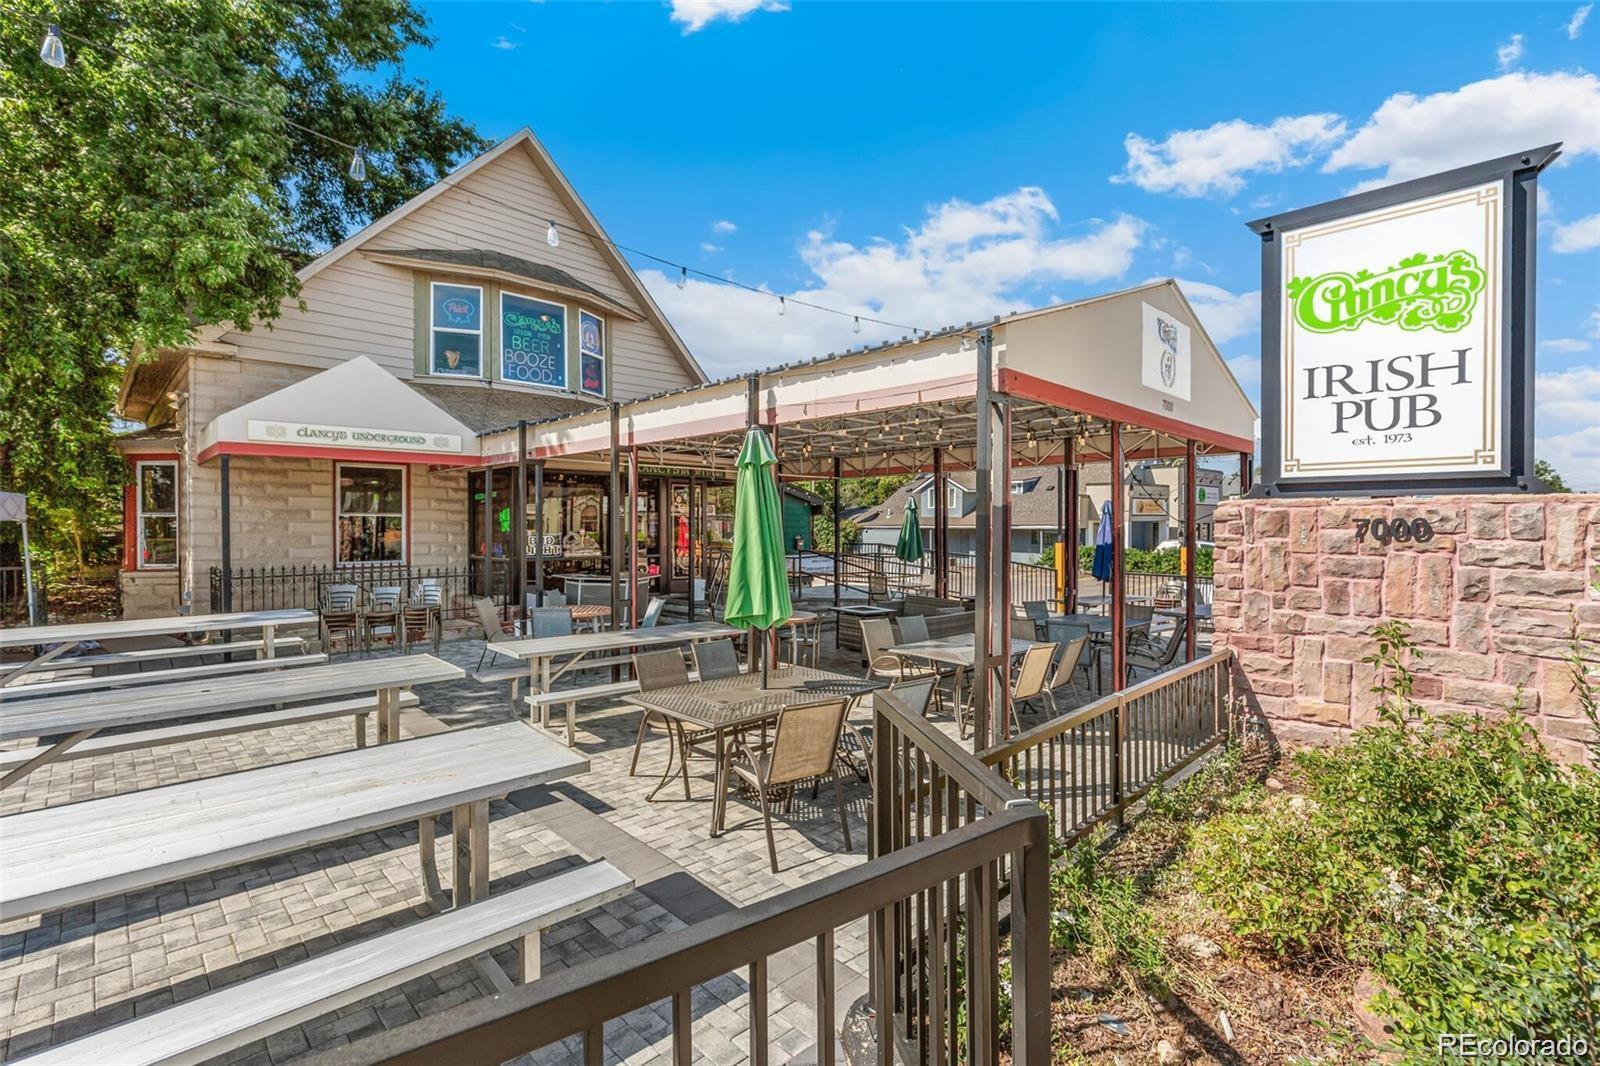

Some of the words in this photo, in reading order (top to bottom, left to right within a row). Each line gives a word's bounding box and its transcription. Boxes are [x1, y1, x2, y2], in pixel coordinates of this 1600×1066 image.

[512, 336, 550, 354] BEER
[504, 349, 556, 370] BOOZE
[505, 363, 553, 382] FOOD
[1302, 347, 1473, 400] IRISH
[1331, 393, 1442, 434] PUB
[1351, 435, 1376, 446] est.
[1384, 432, 1413, 444] 1973
[1352, 517, 1433, 543] 7000
